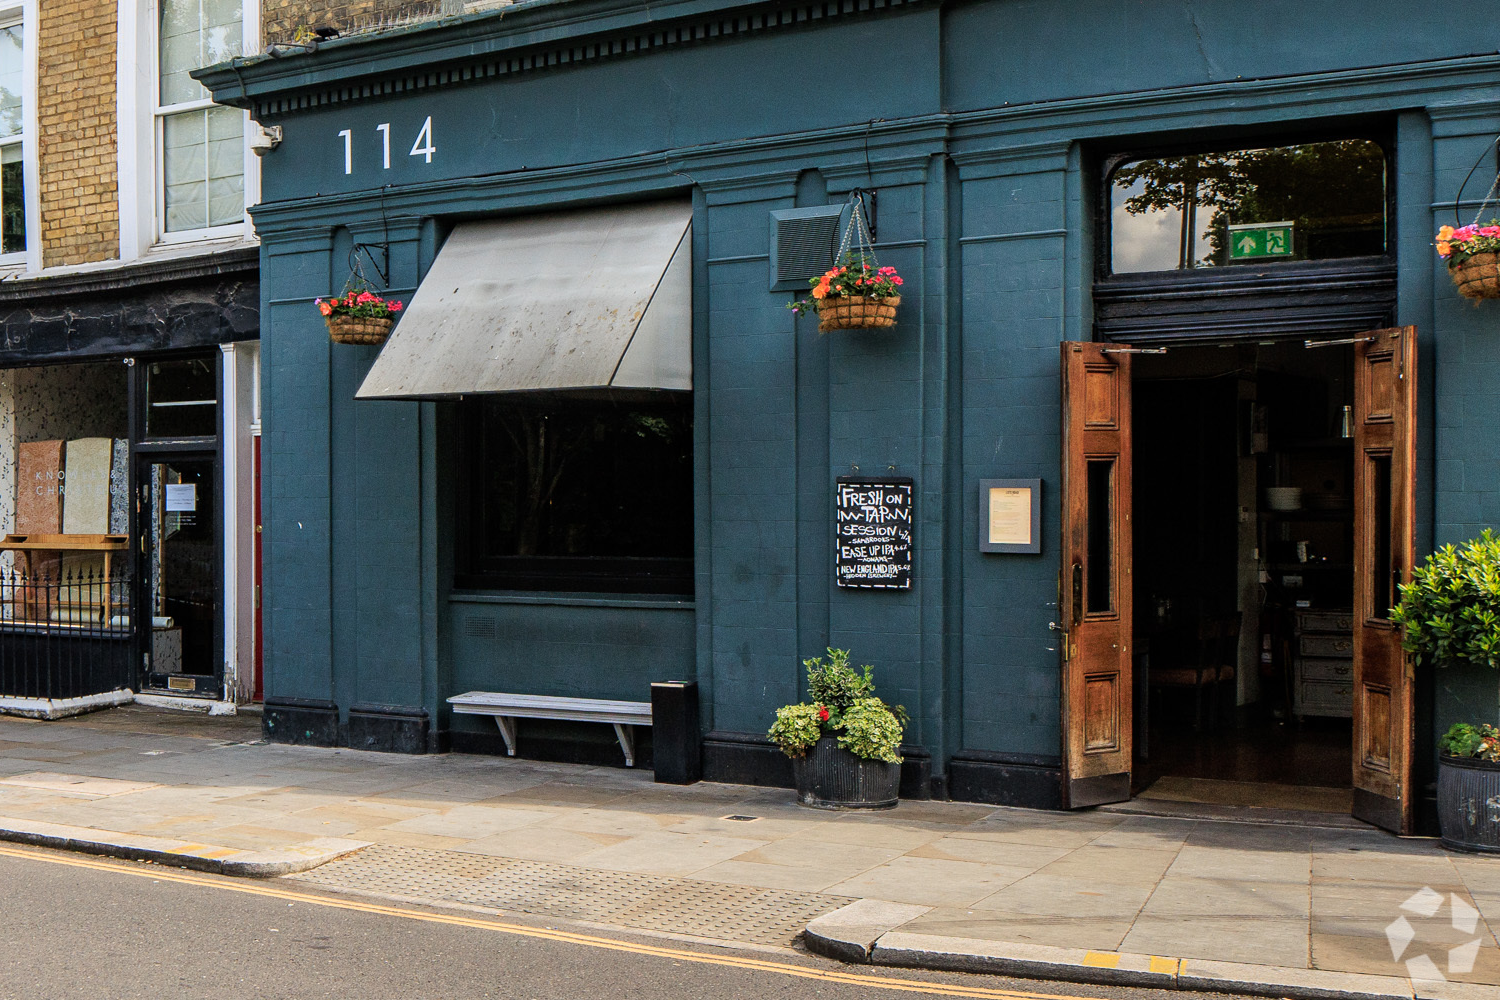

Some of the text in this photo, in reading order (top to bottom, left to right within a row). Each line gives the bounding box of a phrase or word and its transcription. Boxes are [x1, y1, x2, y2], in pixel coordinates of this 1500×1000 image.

[337, 115, 436, 175] 114
[842, 487, 903, 508] FRESH ON
[860, 504, 890, 523] TAP
[841, 524, 898, 536] SESSION
[841, 545, 868, 559] EASE
[868, 544, 881, 557] UP
[881, 543, 895, 556] IPA
[840, 564, 857, 575] NEW
[857, 563, 888, 574] ENGLAND
[888, 563, 899, 574] IPA
